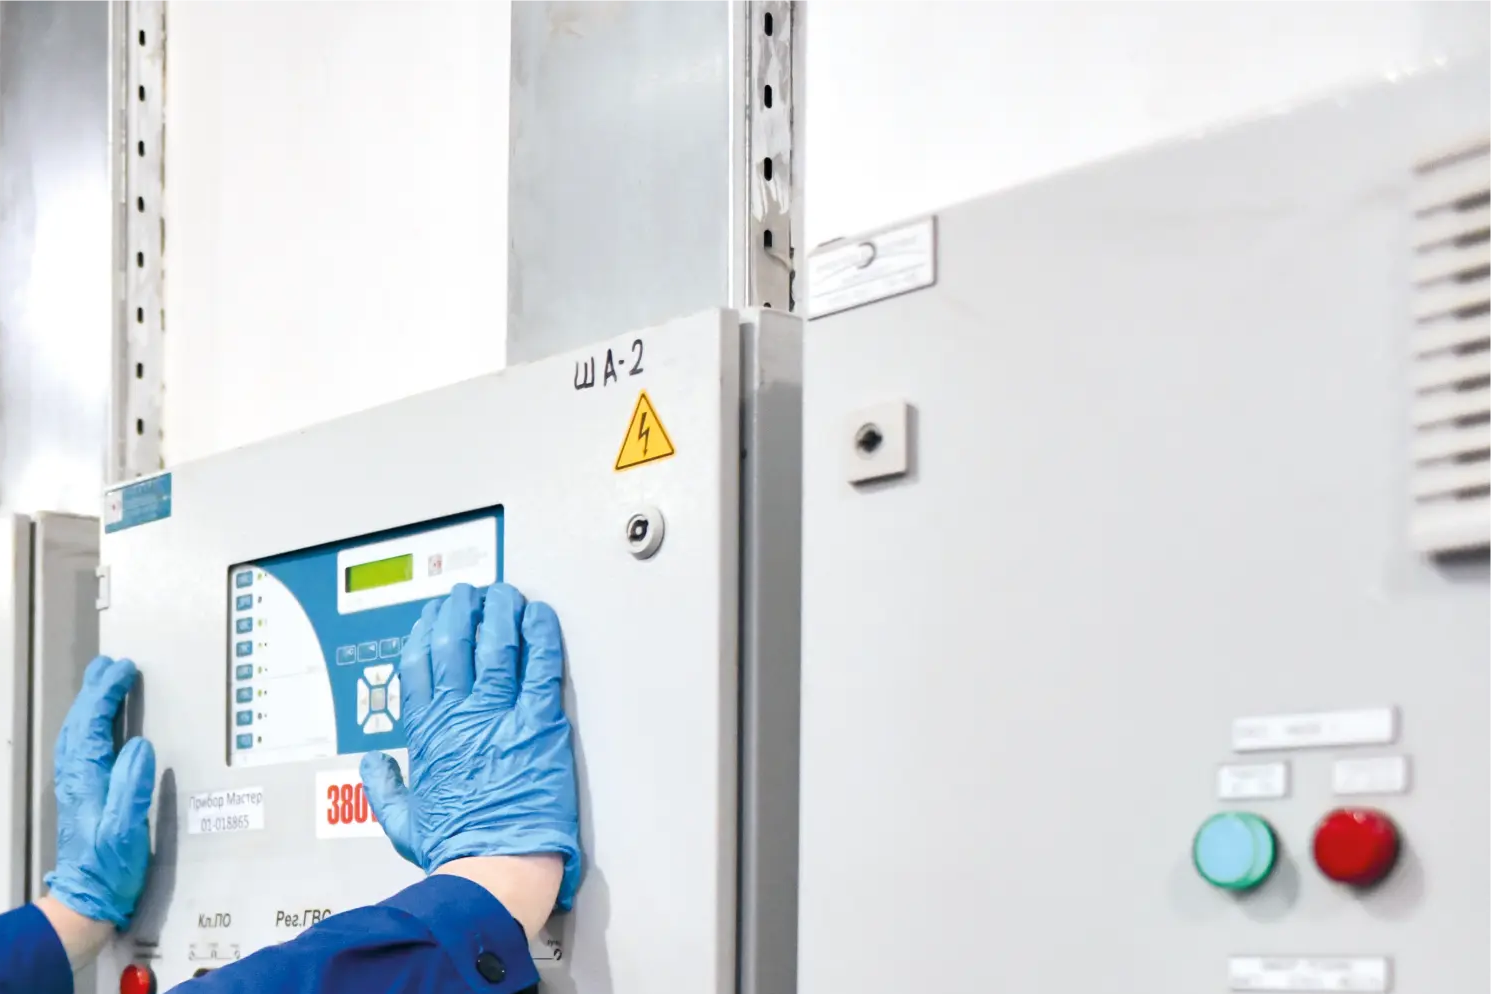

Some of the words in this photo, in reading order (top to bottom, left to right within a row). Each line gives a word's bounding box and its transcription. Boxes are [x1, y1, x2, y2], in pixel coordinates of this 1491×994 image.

[573, 338, 645, 390] ША-2
[189, 793, 224, 813] Прибор
[226, 790, 263, 808] Мастер
[326, 782, 379, 825] 380
